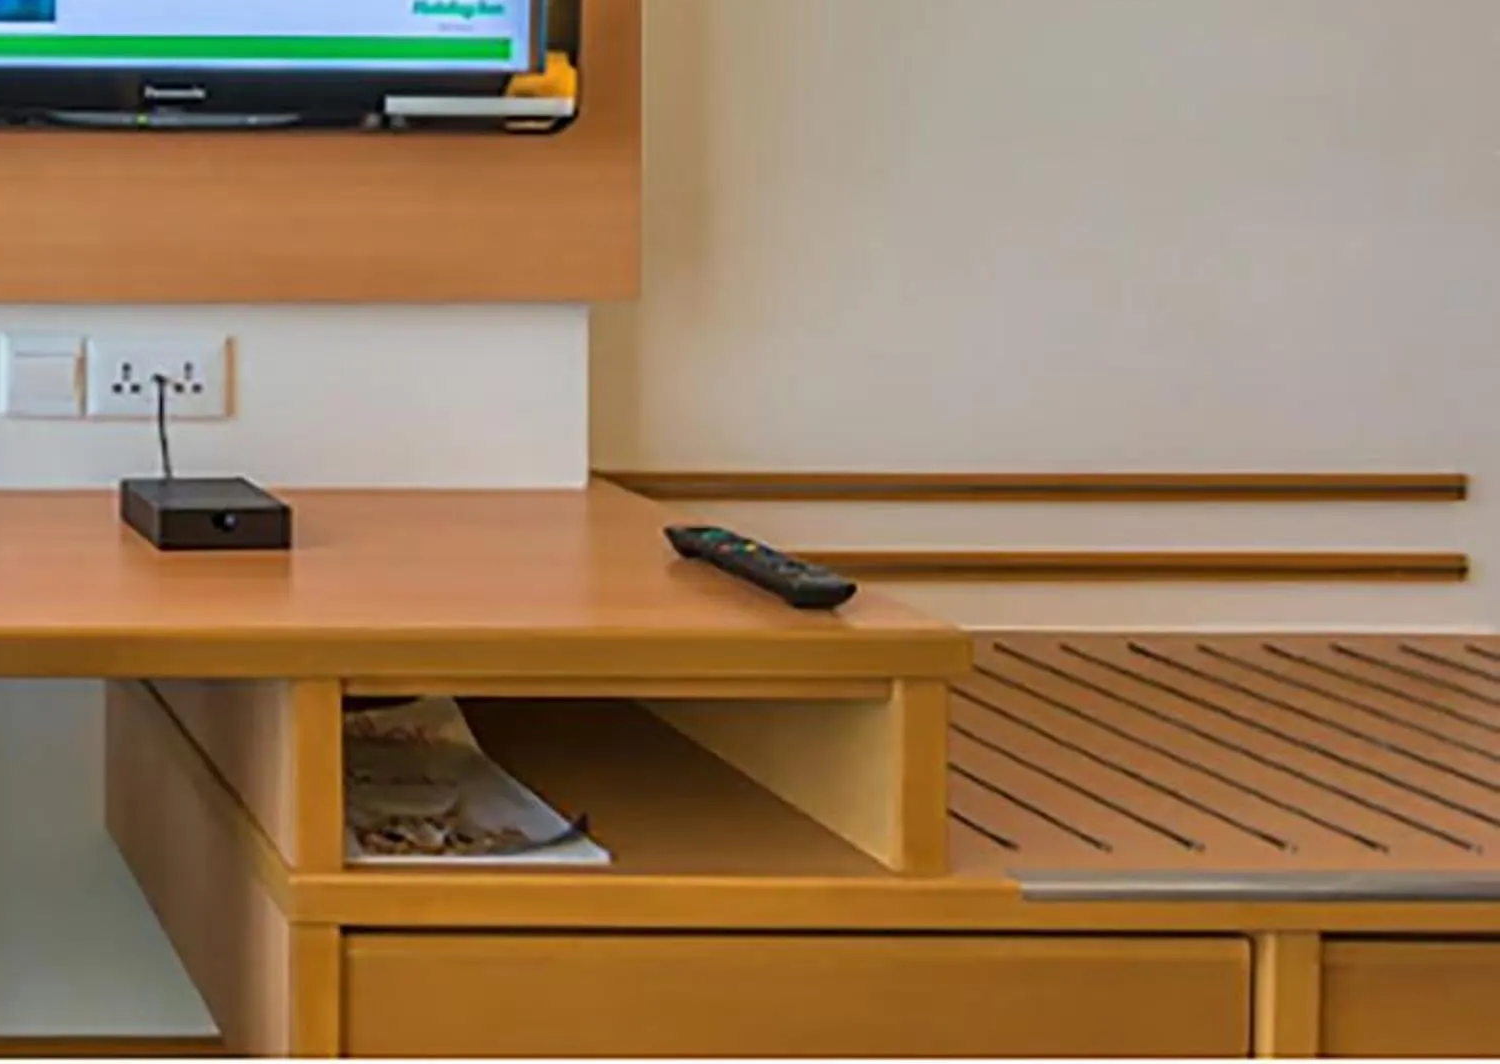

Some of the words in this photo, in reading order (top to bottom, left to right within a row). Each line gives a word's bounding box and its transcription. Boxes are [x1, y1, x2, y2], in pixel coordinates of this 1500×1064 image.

[412, 0, 475, 19] Holiday
[477, 0, 505, 15] Inn
[144, 85, 206, 99] Panasonic
